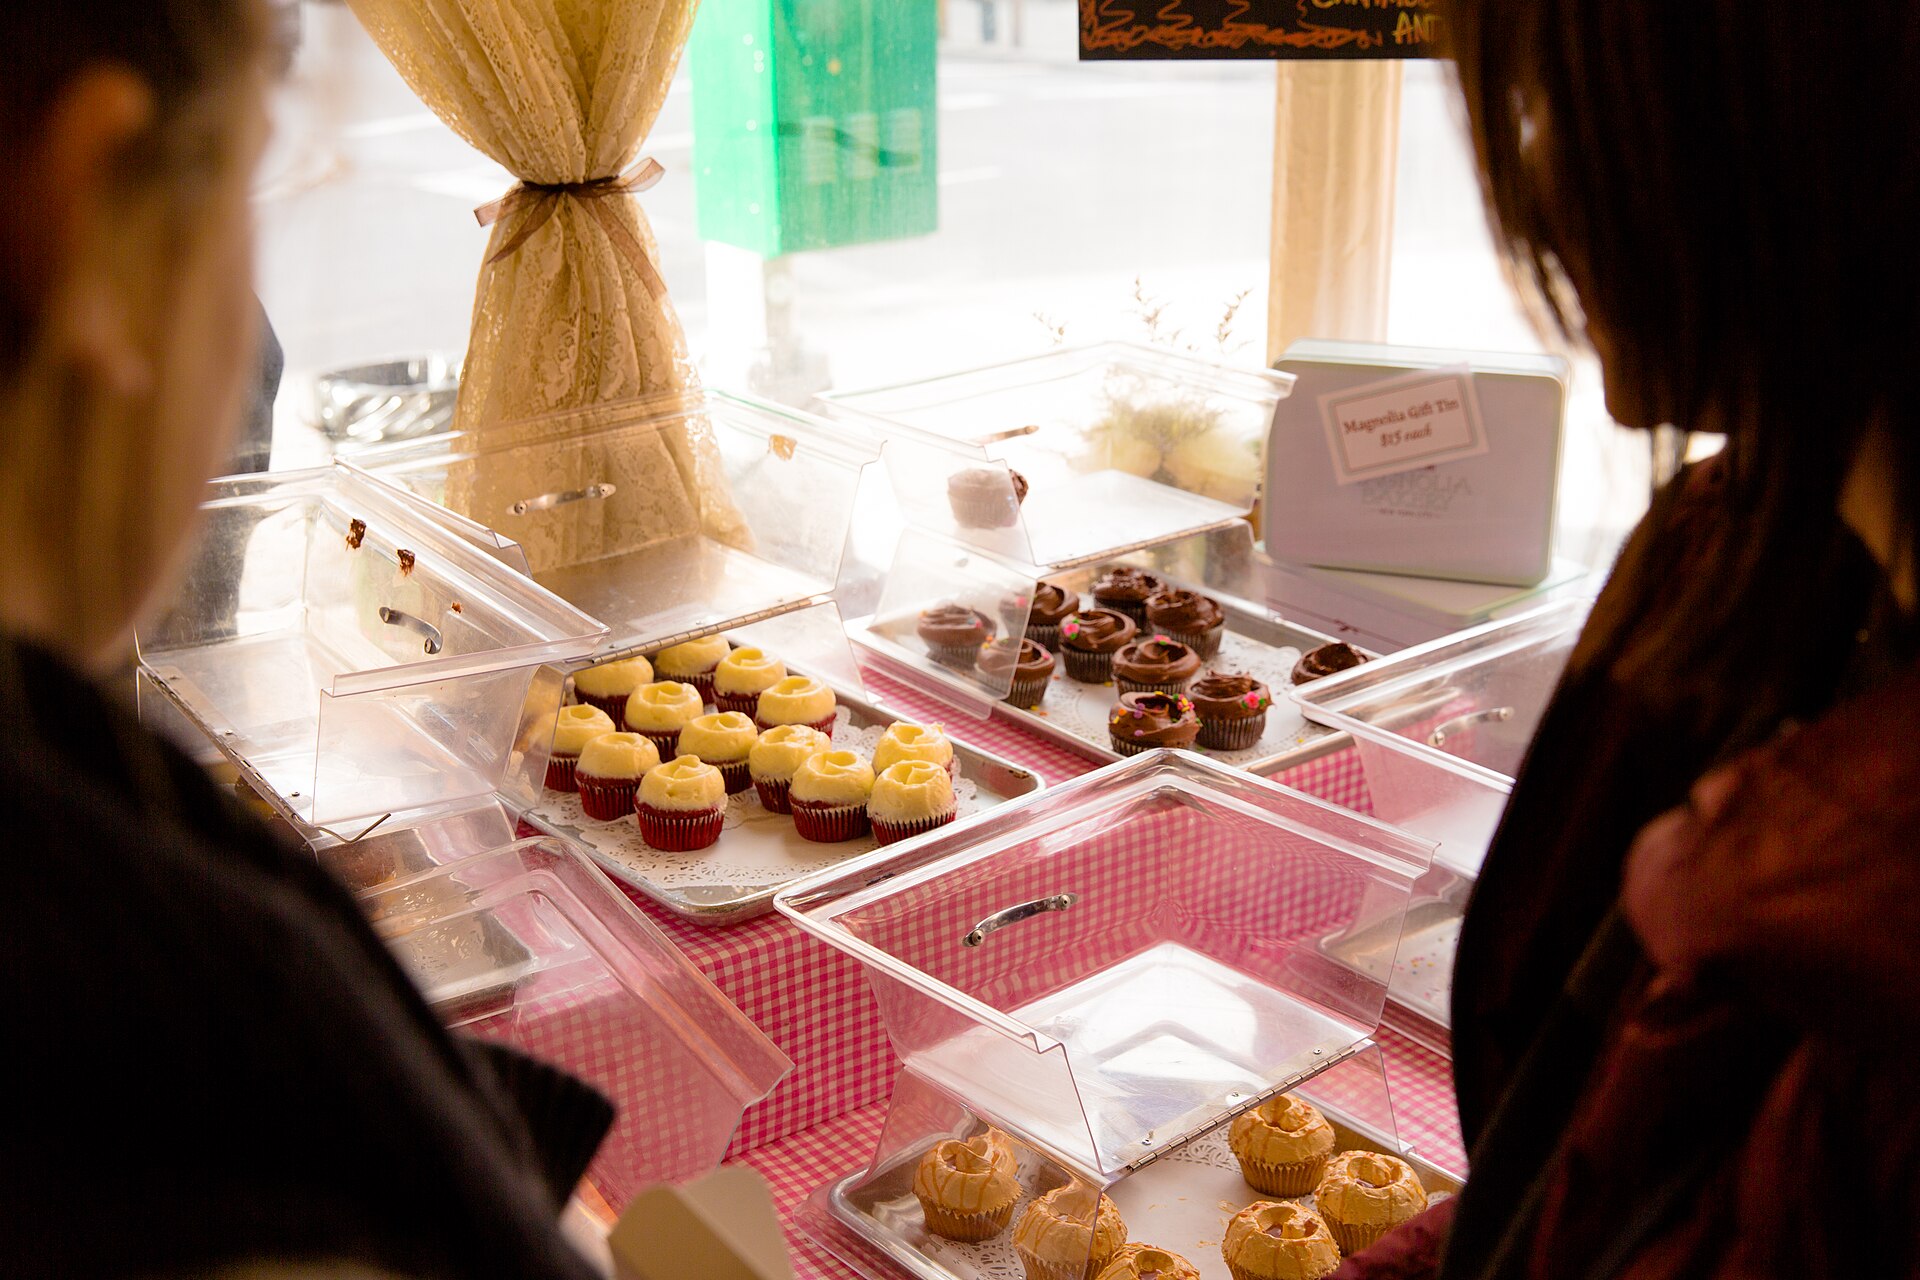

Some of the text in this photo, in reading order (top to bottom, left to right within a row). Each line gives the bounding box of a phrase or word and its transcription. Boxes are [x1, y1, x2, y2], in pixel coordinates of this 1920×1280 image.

[1343, 398, 1460, 435] Magnolia Gift Tin
[1380, 422, 1433, 447] $15 each
